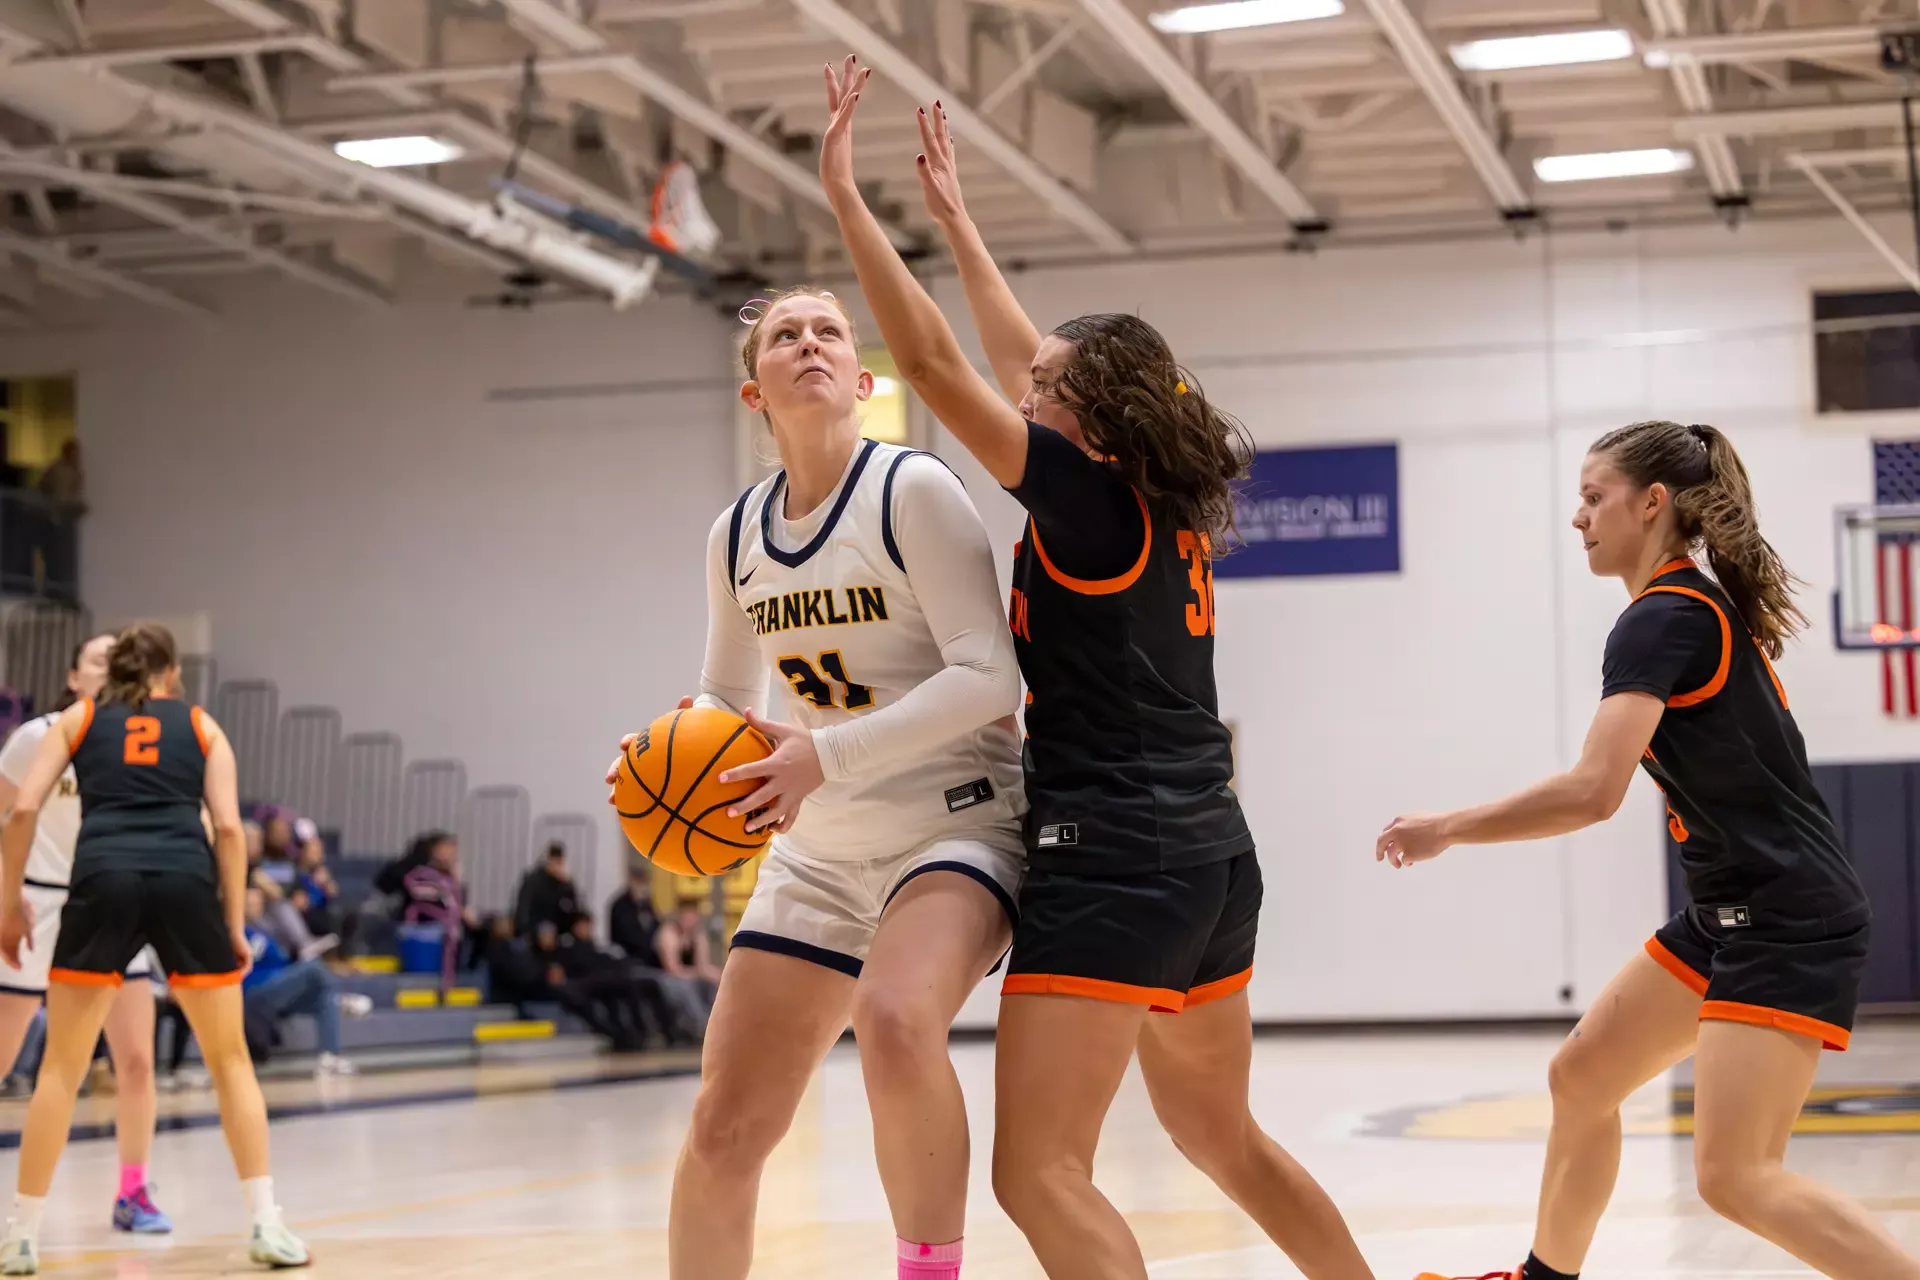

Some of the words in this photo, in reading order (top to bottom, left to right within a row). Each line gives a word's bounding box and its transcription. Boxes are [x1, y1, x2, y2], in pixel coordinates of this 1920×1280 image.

[1228, 495, 1354, 525] IVISION
[777, 648, 875, 712] 31
[124, 715, 161, 765] 2
[979, 786, 987, 796] L
[1063, 829, 1070, 839] L
[1736, 912, 1745, 921] M
